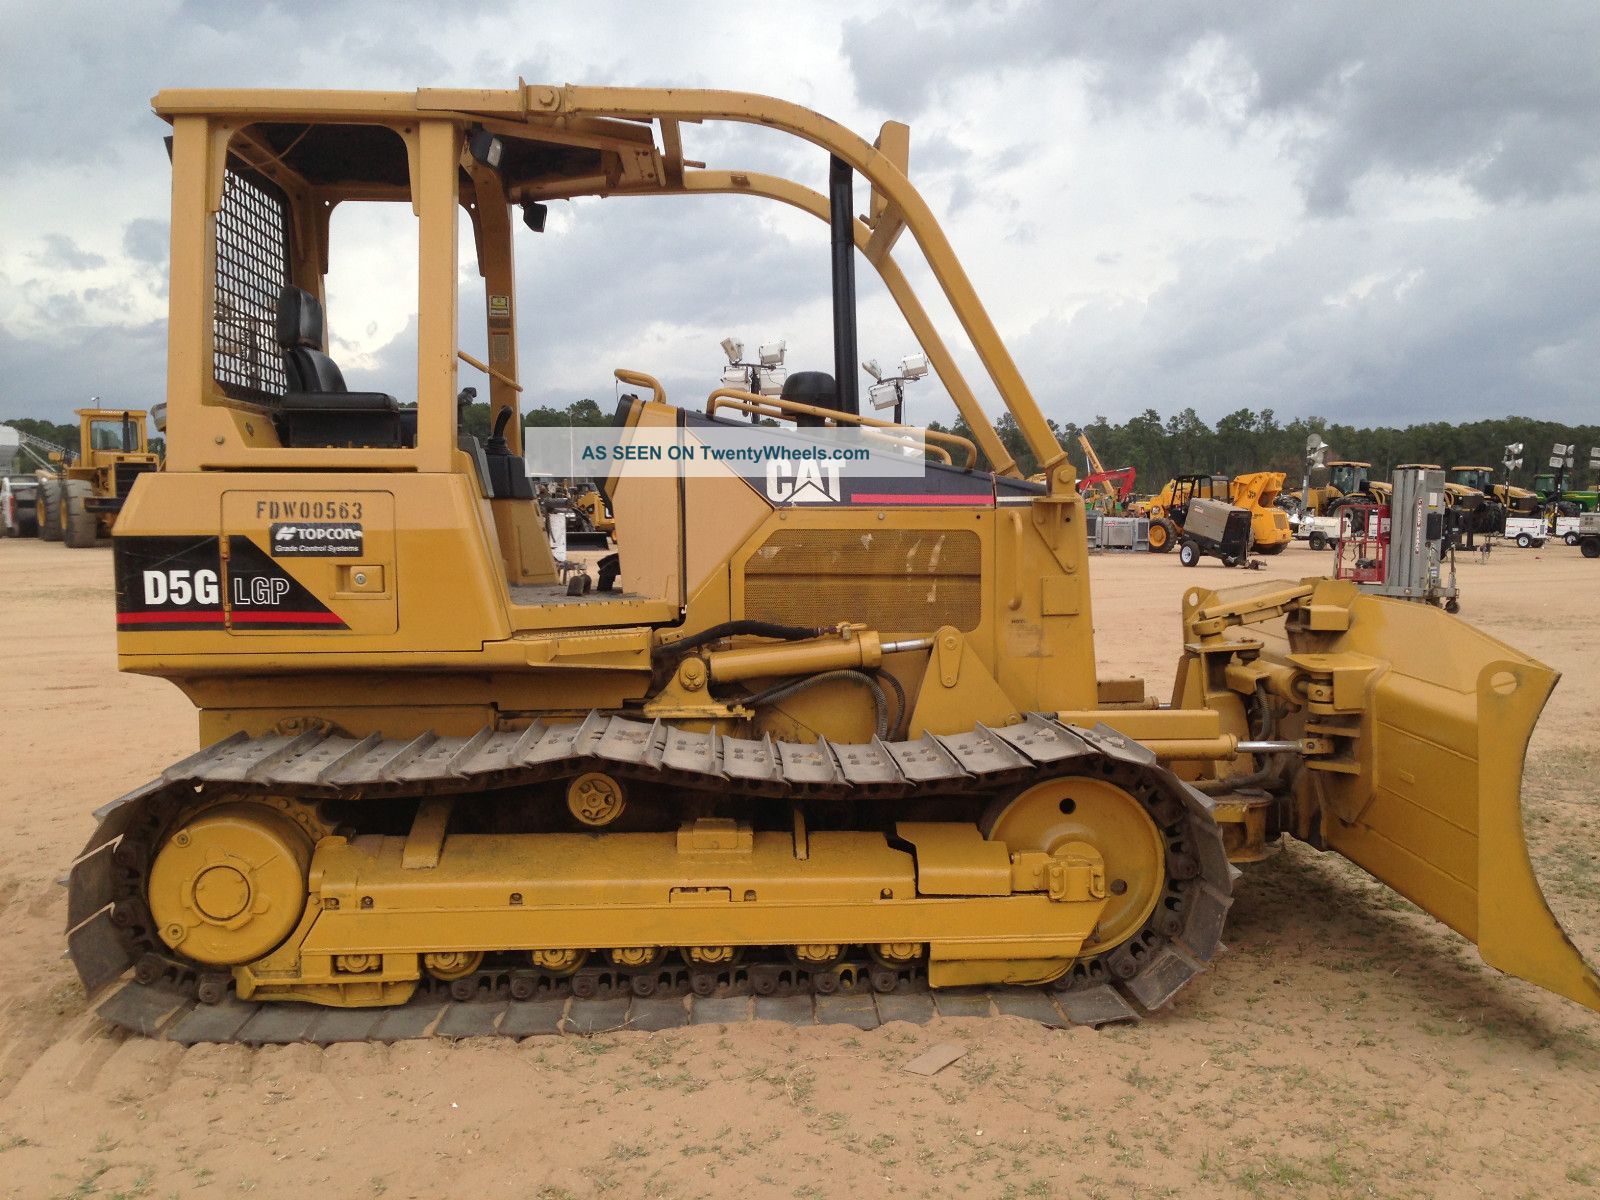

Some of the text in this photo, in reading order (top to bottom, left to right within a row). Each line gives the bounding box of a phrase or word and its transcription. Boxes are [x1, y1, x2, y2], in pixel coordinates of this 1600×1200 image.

[766, 458, 847, 502] CAT
[256, 501, 362, 519] FDW00563
[275, 544, 359, 554] Grade Control Systems
[143, 569, 219, 605] D5G
[233, 576, 290, 605] LGP
